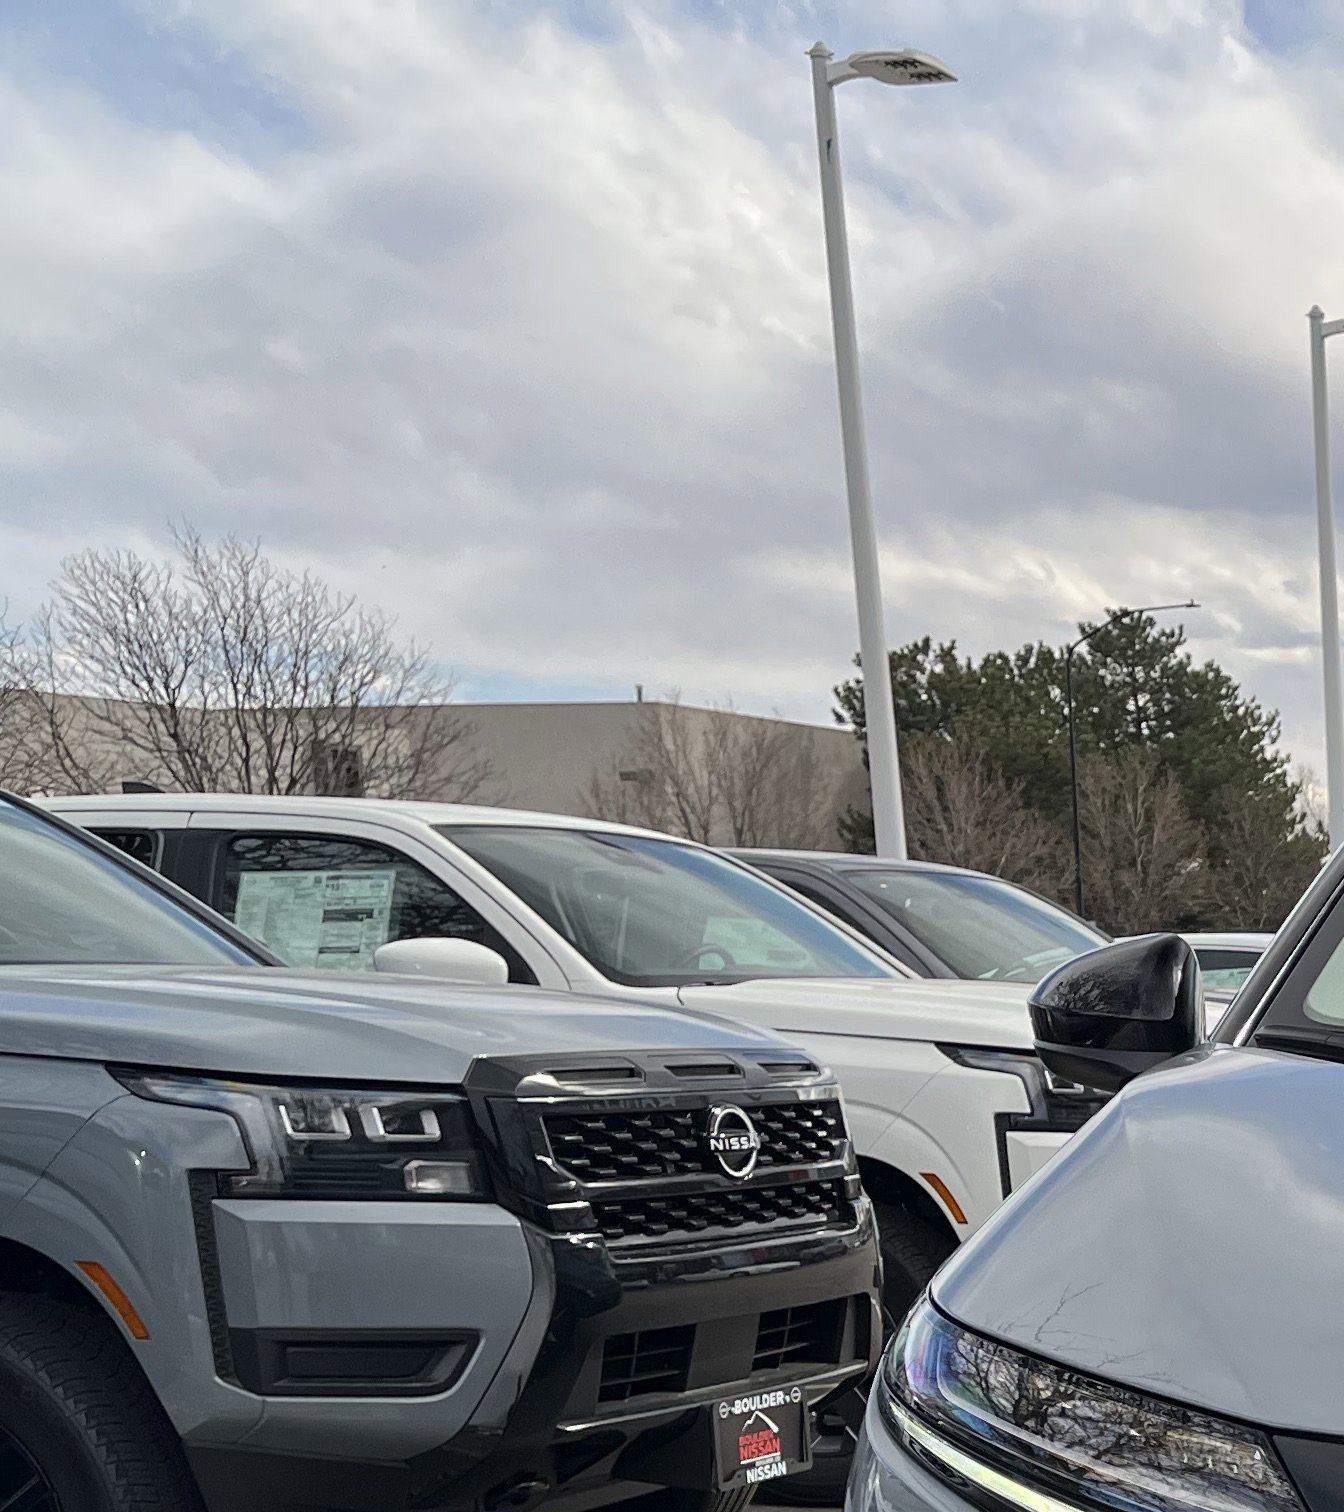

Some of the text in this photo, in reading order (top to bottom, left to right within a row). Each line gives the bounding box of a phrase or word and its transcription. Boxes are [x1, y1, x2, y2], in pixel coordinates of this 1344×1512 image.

[734, 1391, 785, 1415] BOULDER
[740, 1437, 780, 1461] NISSAN
[746, 1461, 786, 1483] NISSAN
